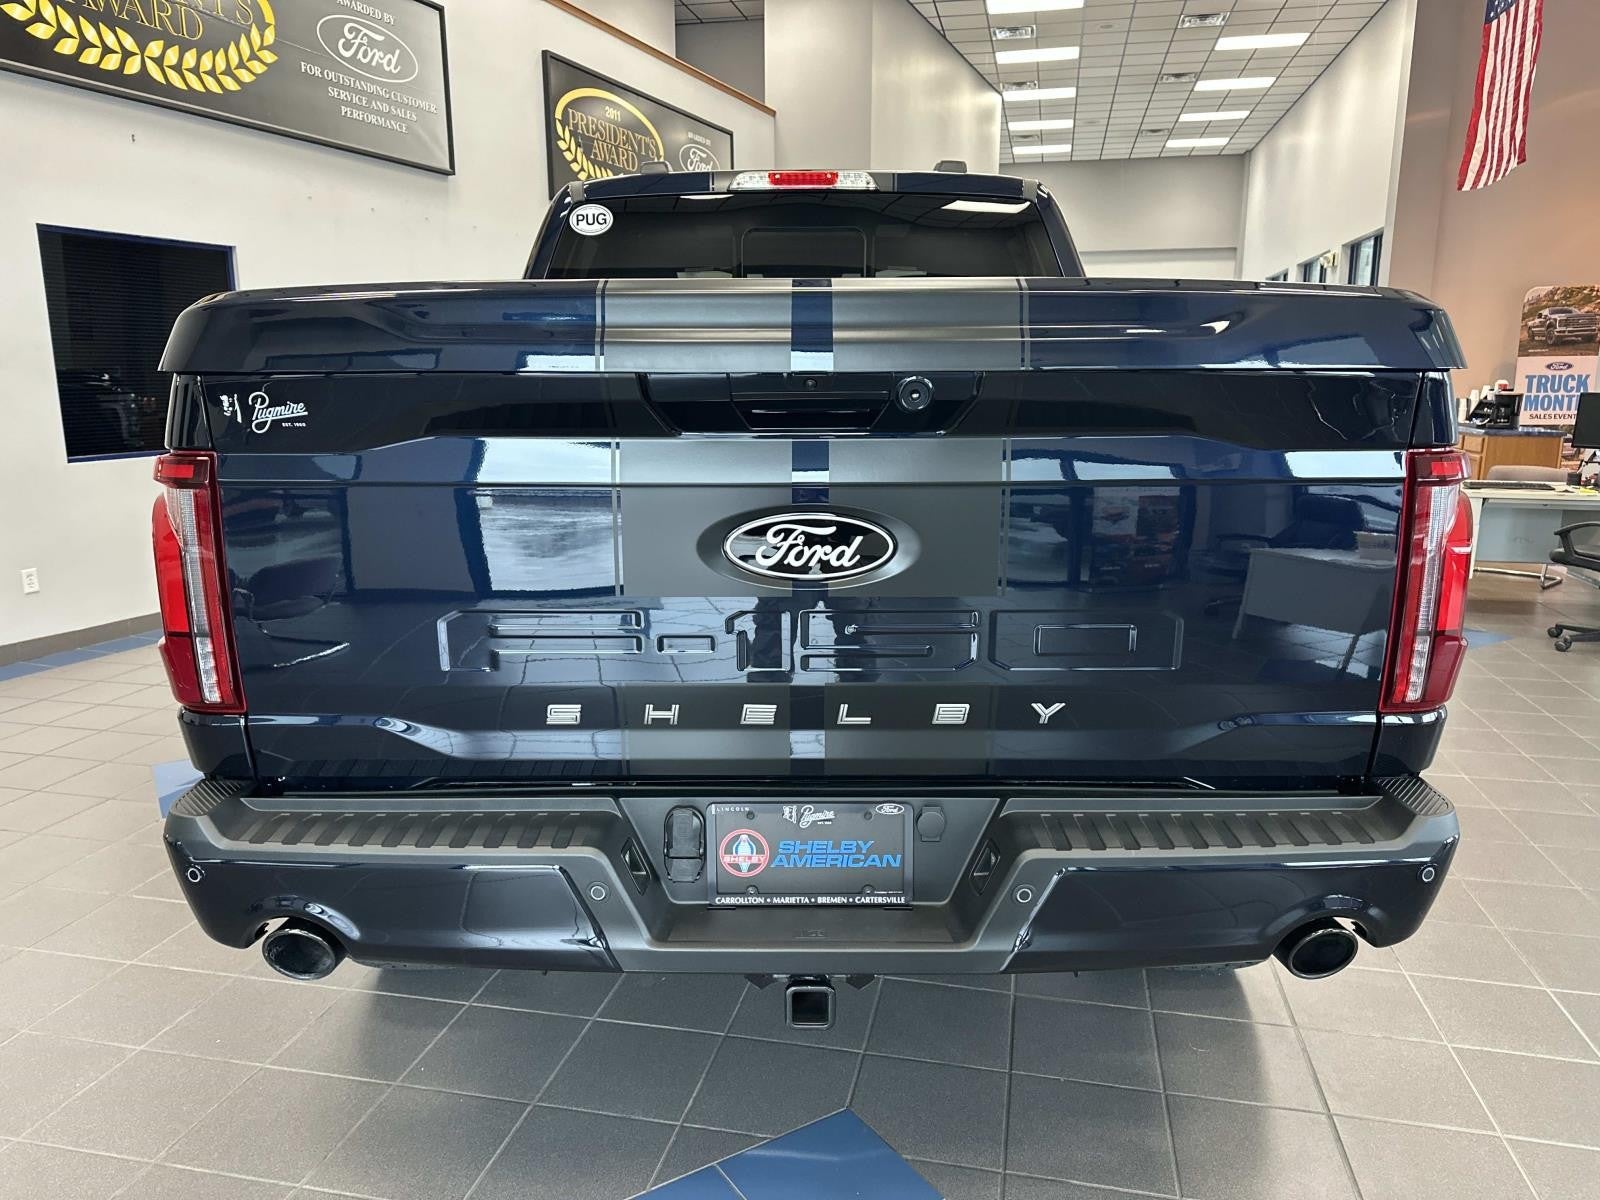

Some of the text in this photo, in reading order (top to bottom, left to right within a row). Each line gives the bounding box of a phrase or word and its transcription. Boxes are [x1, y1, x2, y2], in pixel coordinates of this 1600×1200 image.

[383, 12, 394, 24] BY
[338, 22, 401, 74] Ford
[300, 61, 438, 114] FOR OUTSTANDING CUSTOMER
[327, 86, 418, 122] SERVICE AND SALES
[605, 106, 622, 122] 2011
[340, 105, 409, 134] PERFORMANCE
[567, 107, 656, 159] PRESIDENT'S
[590, 138, 638, 172] AWARD
[687, 148, 714, 171] Ford
[576, 213, 608, 227] PUG
[1525, 374, 1590, 394] TRUCK
[248, 391, 309, 434] Pugmire
[755, 523, 864, 568] Ford
[545, 702, 1066, 727] SHELBY
[778, 840, 875, 854] SHELBY
[770, 854, 902, 868] AMERICAN
[715, 896, 906, 905] CARROLLTON MARIETTA BREMEN CARTERSVILLE
